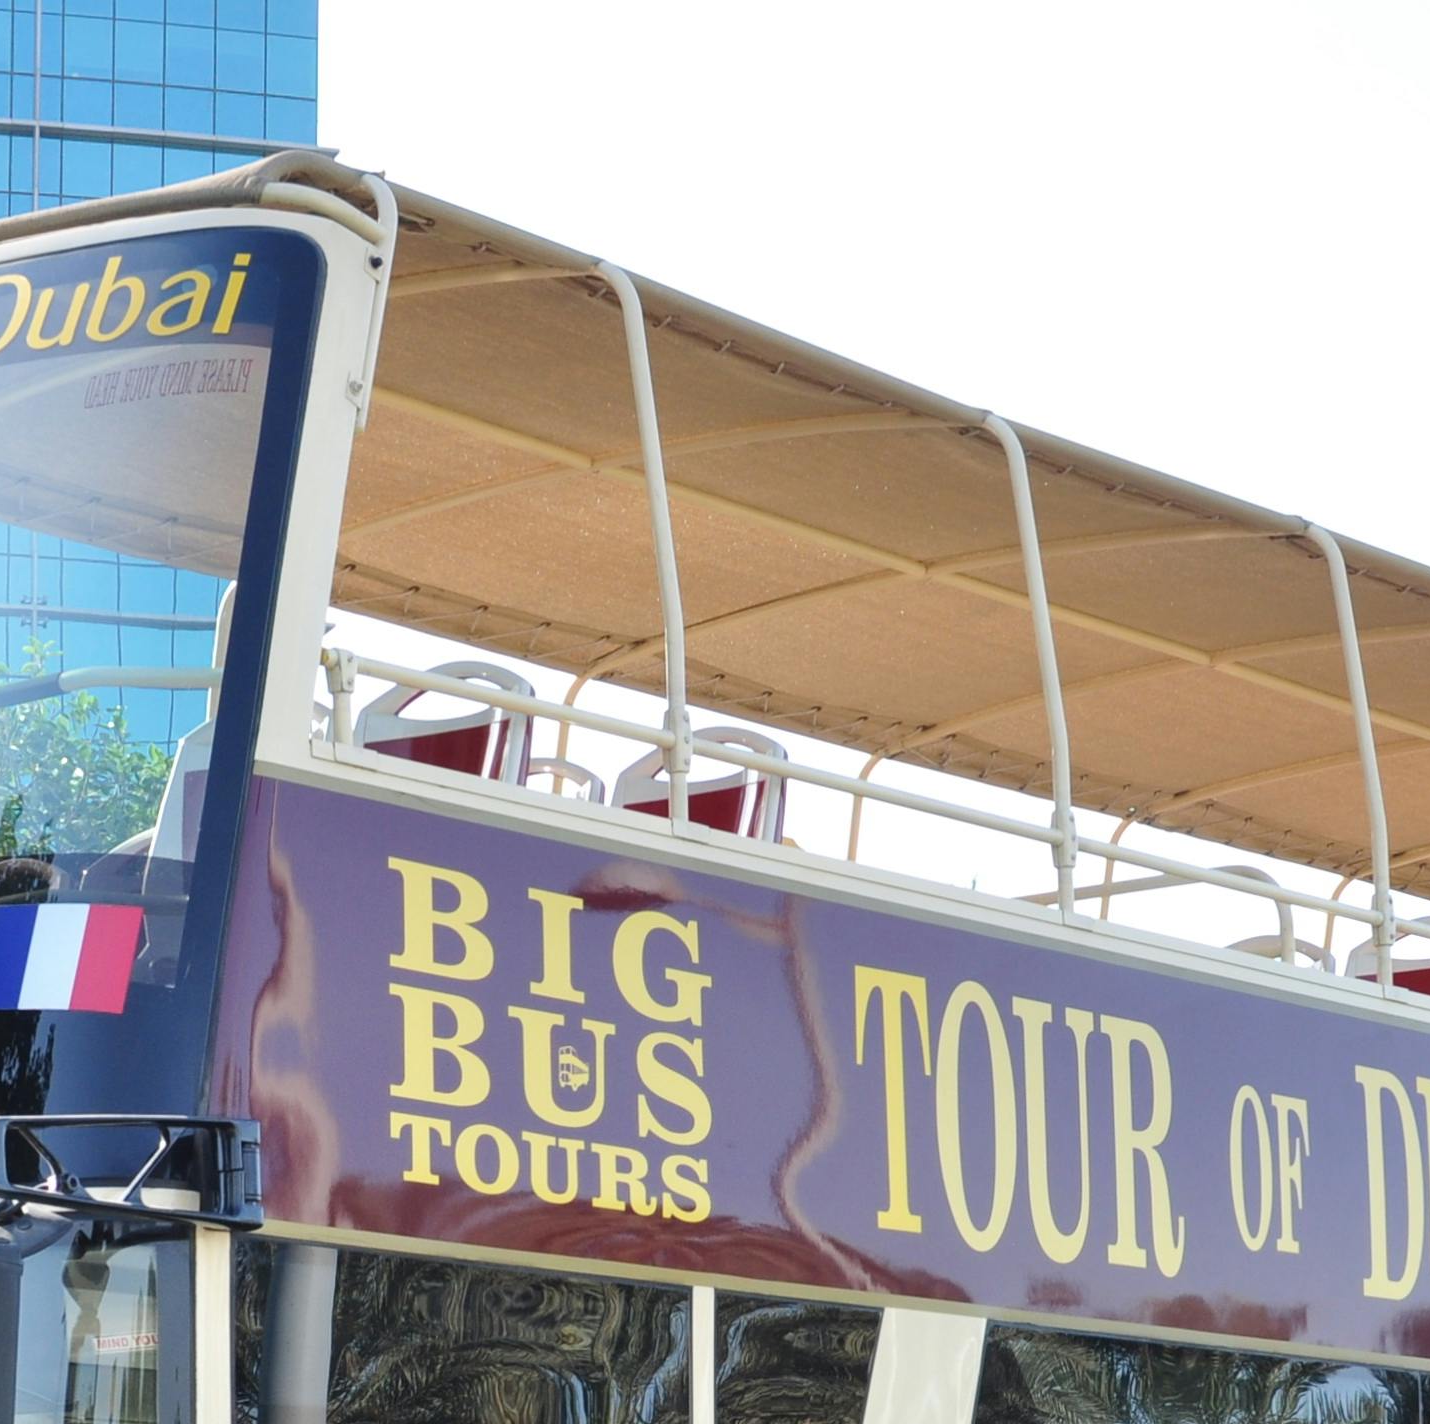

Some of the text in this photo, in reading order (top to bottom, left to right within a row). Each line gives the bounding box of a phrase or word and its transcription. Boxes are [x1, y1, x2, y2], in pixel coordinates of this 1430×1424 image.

[388, 856, 712, 1026] BIG
[388, 982, 712, 1146] BUS
[854, 965, 1185, 1278] TOUR
[1229, 1084, 1311, 1256] OF
[389, 1111, 712, 1224] TOURS
[134, 1333, 162, 1346] YOU
